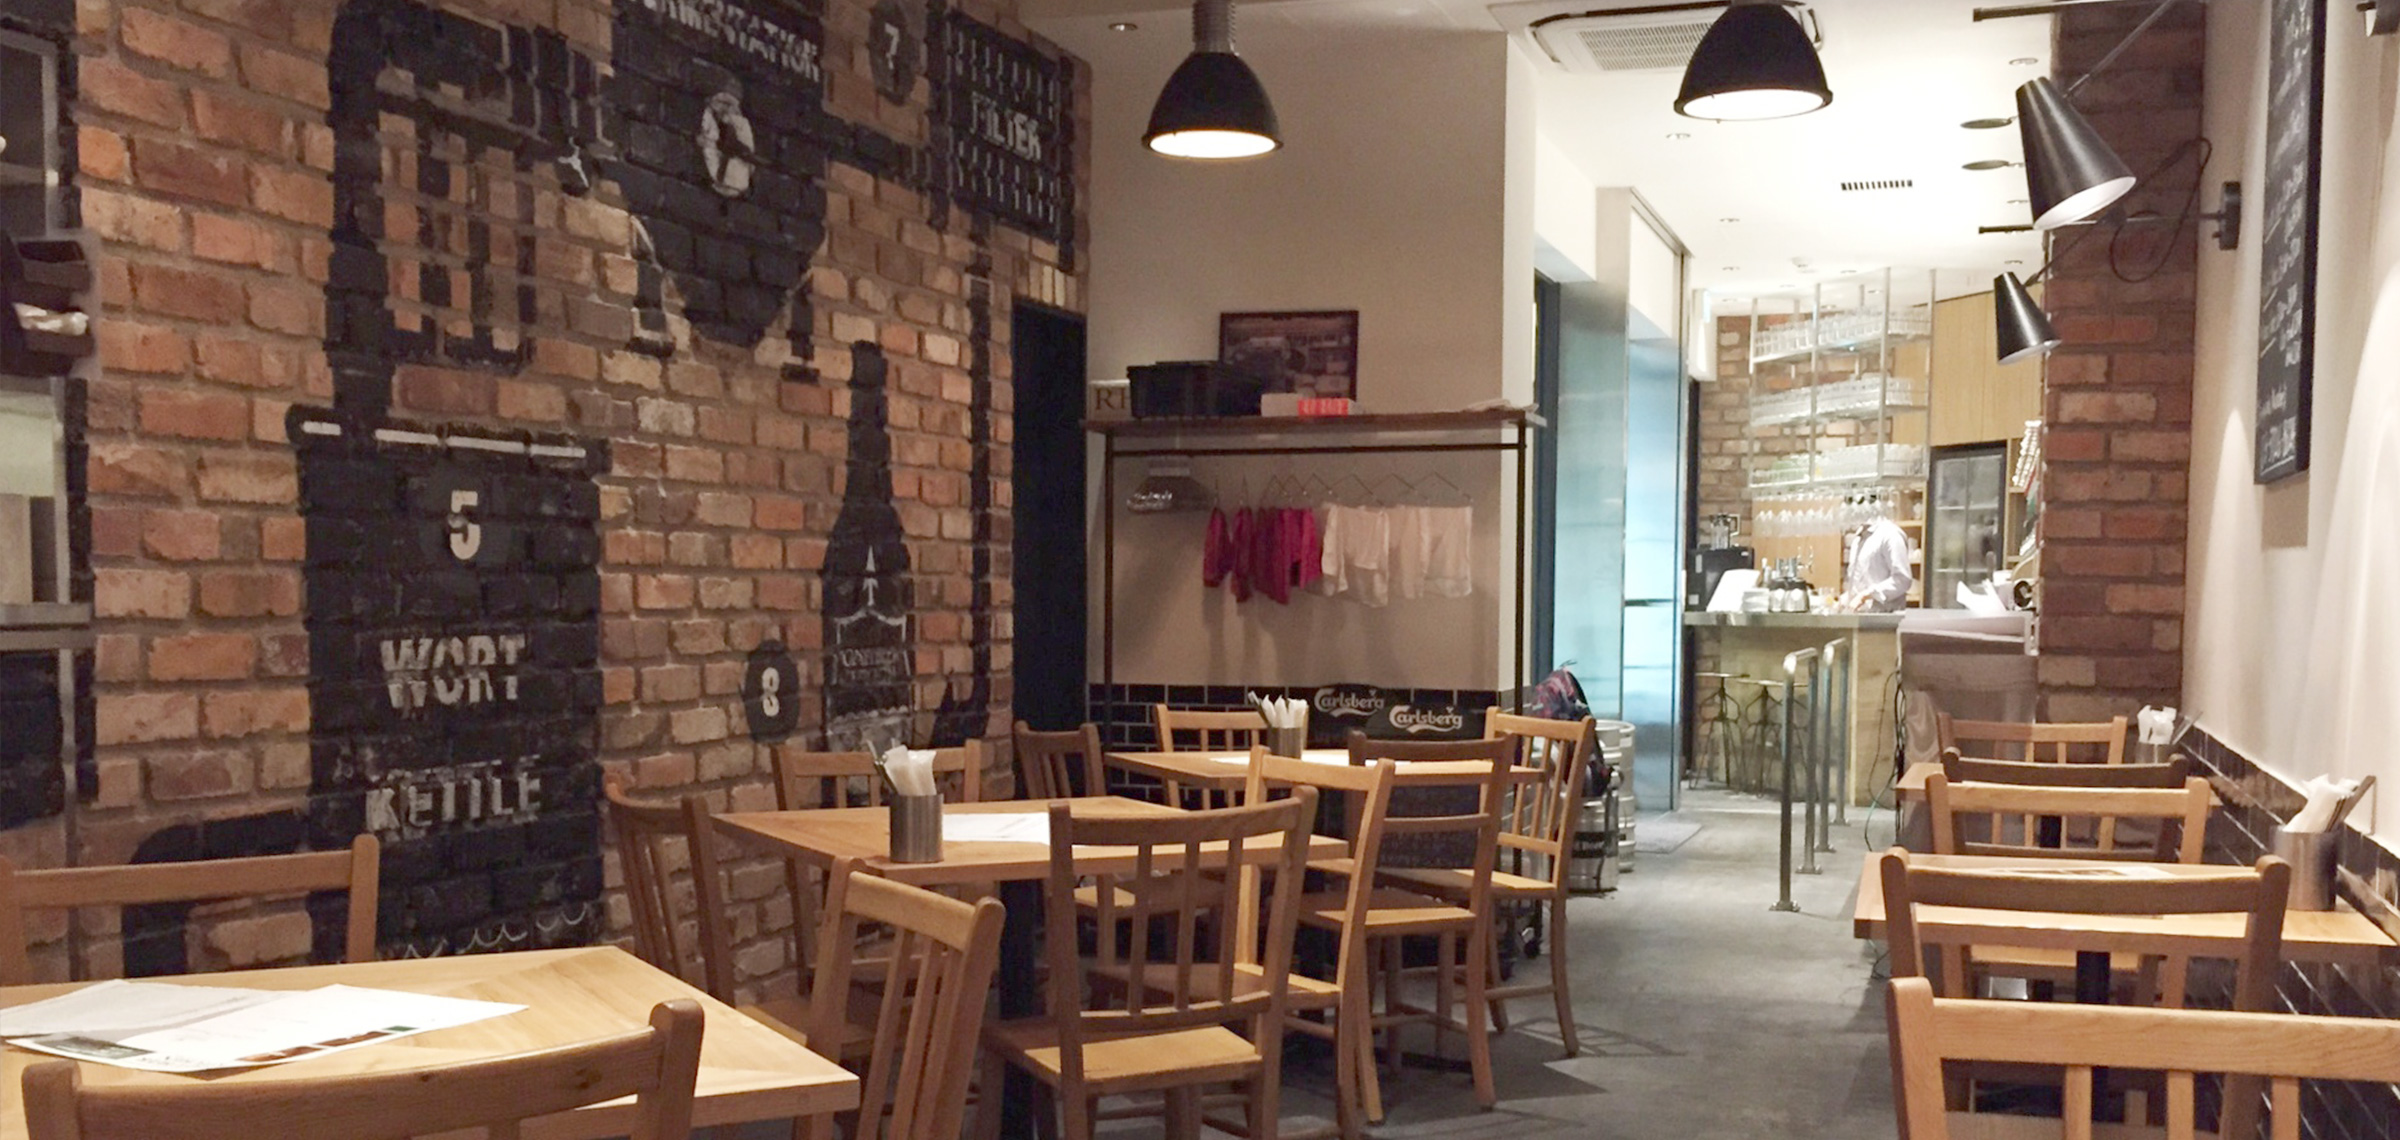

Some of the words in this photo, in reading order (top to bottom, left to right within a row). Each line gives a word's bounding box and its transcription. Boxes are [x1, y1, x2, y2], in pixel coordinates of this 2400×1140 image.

[885, 22, 899, 70] 7
[969, 91, 1042, 164] FILTER
[450, 489, 481, 560] 5
[380, 633, 526, 710] WORT
[761, 666, 780, 717] 8
[1314, 688, 1385, 714] Carlsberg
[1389, 705, 1463, 731] Carlsberg
[365, 754, 542, 842] KETTLE
